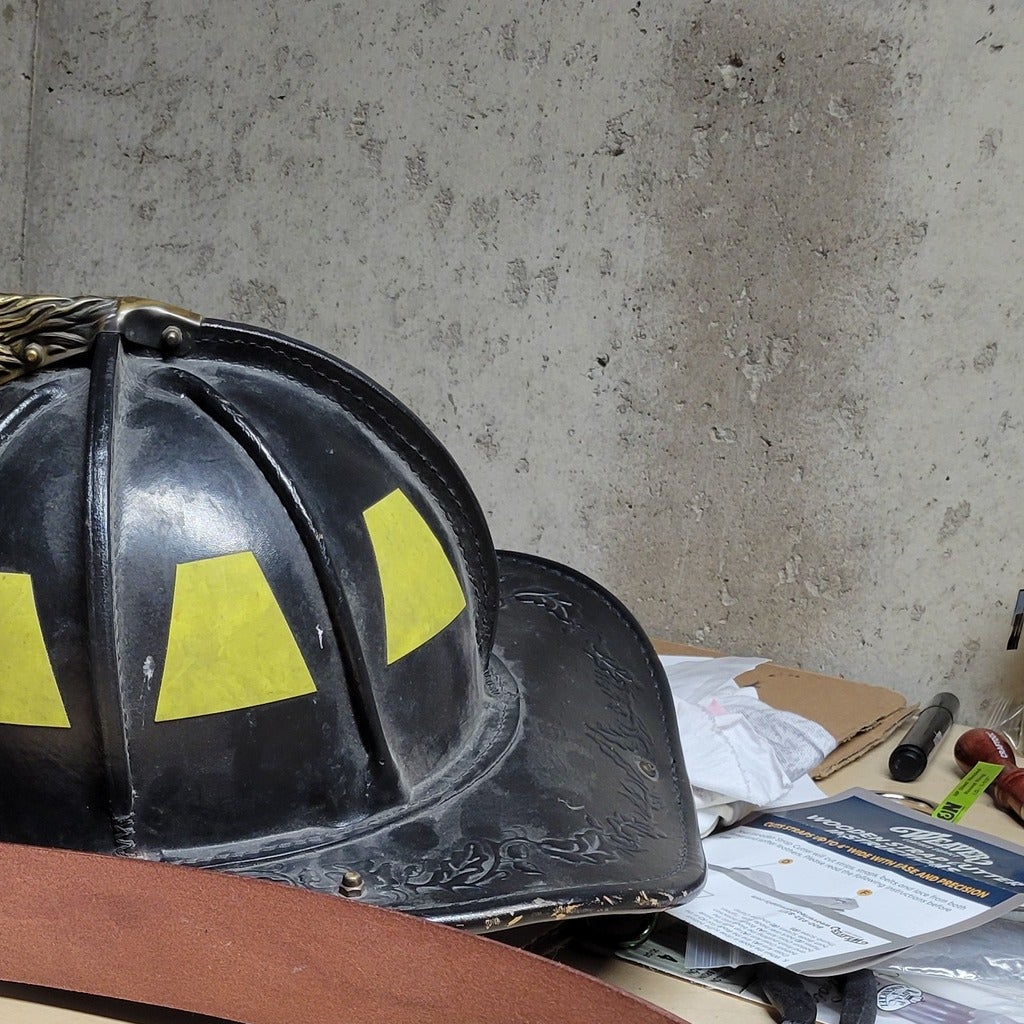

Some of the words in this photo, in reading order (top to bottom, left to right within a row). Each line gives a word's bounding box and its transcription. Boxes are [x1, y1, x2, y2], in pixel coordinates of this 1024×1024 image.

[806, 814, 890, 842] WOODEN
[884, 841, 950, 863] STRAP
[847, 847, 873, 859] WIDE
[871, 854, 898, 867] WITH
[894, 861, 921, 875] EASE
[916, 871, 940, 883] AND
[936, 876, 990, 899] PRECISION
